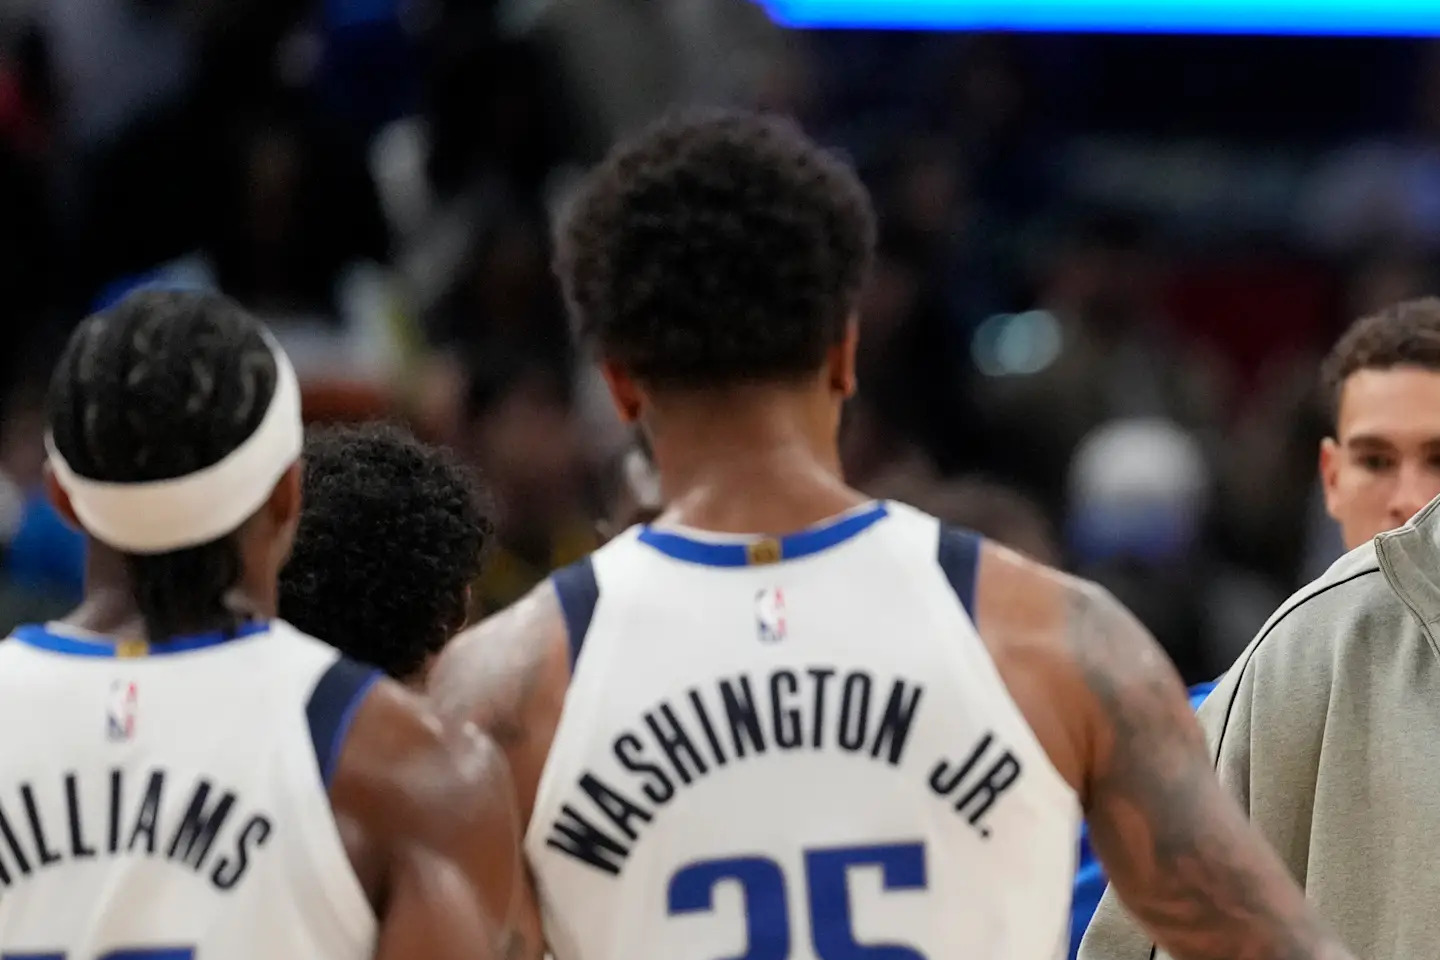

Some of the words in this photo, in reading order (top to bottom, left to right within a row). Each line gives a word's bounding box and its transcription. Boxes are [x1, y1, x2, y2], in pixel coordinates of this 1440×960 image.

[0, 769, 272, 891] ILLIAMS
[545, 668, 925, 878] WASHINGTON
[927, 732, 1024, 839] JR.
